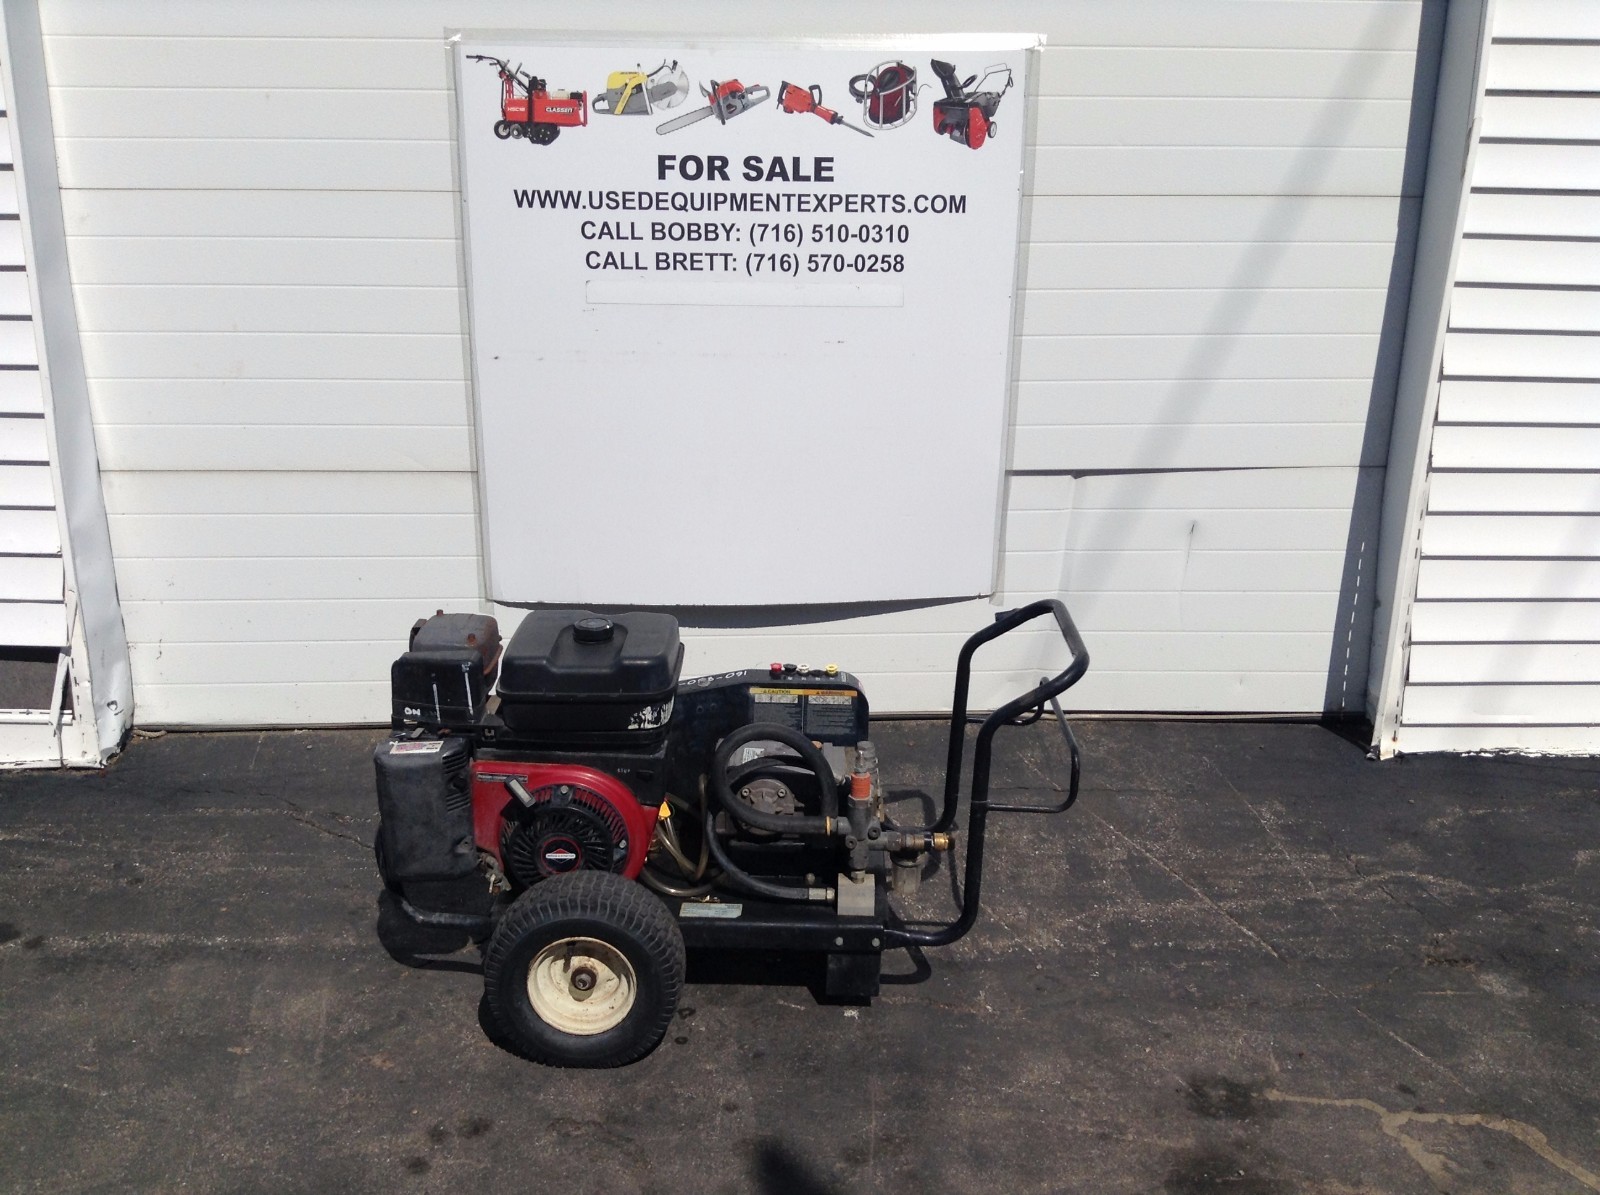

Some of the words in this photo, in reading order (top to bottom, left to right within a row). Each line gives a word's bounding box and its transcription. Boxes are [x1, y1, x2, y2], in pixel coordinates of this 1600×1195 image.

[658, 155, 730, 181] FOR
[743, 156, 834, 182] SALE
[514, 190, 966, 213] WWW.USEDEQUIPMENTEXPERTS.COM
[581, 221, 643, 240] CALL
[652, 222, 740, 241] BOBBY:
[750, 223, 803, 247] (716)
[812, 224, 909, 243] 510-0310
[586, 251, 647, 270] CALL
[656, 252, 736, 271] BRETT:
[746, 253, 799, 276] (716)
[808, 254, 904, 272] 570-0258
